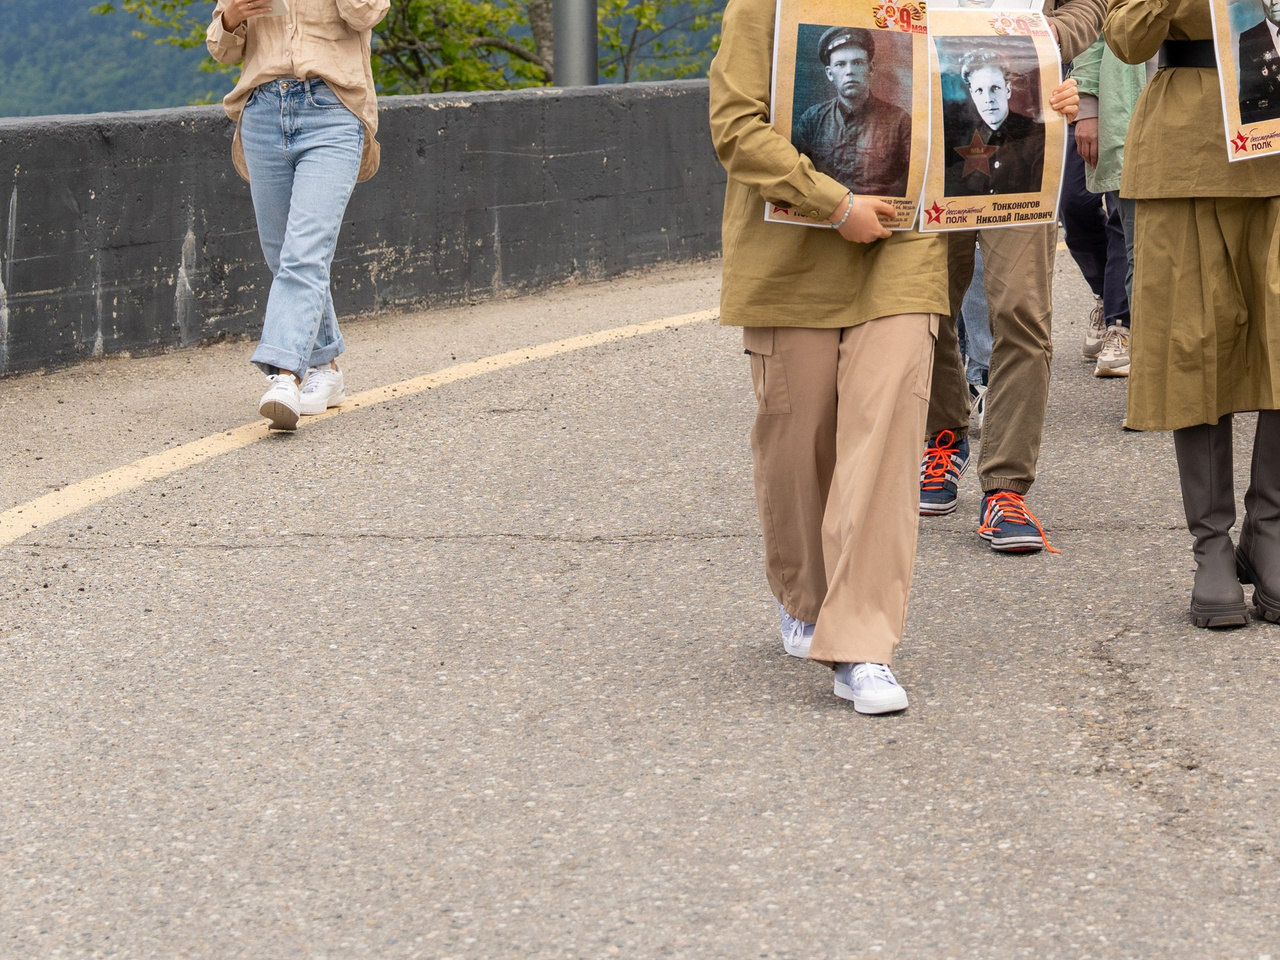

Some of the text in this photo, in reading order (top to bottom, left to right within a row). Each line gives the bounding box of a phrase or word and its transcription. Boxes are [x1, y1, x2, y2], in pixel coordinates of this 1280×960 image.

[900, 8, 912, 32] 9
[1252, 141, 1272, 151] ПОЛК
[992, 201, 1040, 212] Тонконогов
[945, 216, 968, 224] ПОЛК
[976, 211, 1053, 224] Николай Павлович
